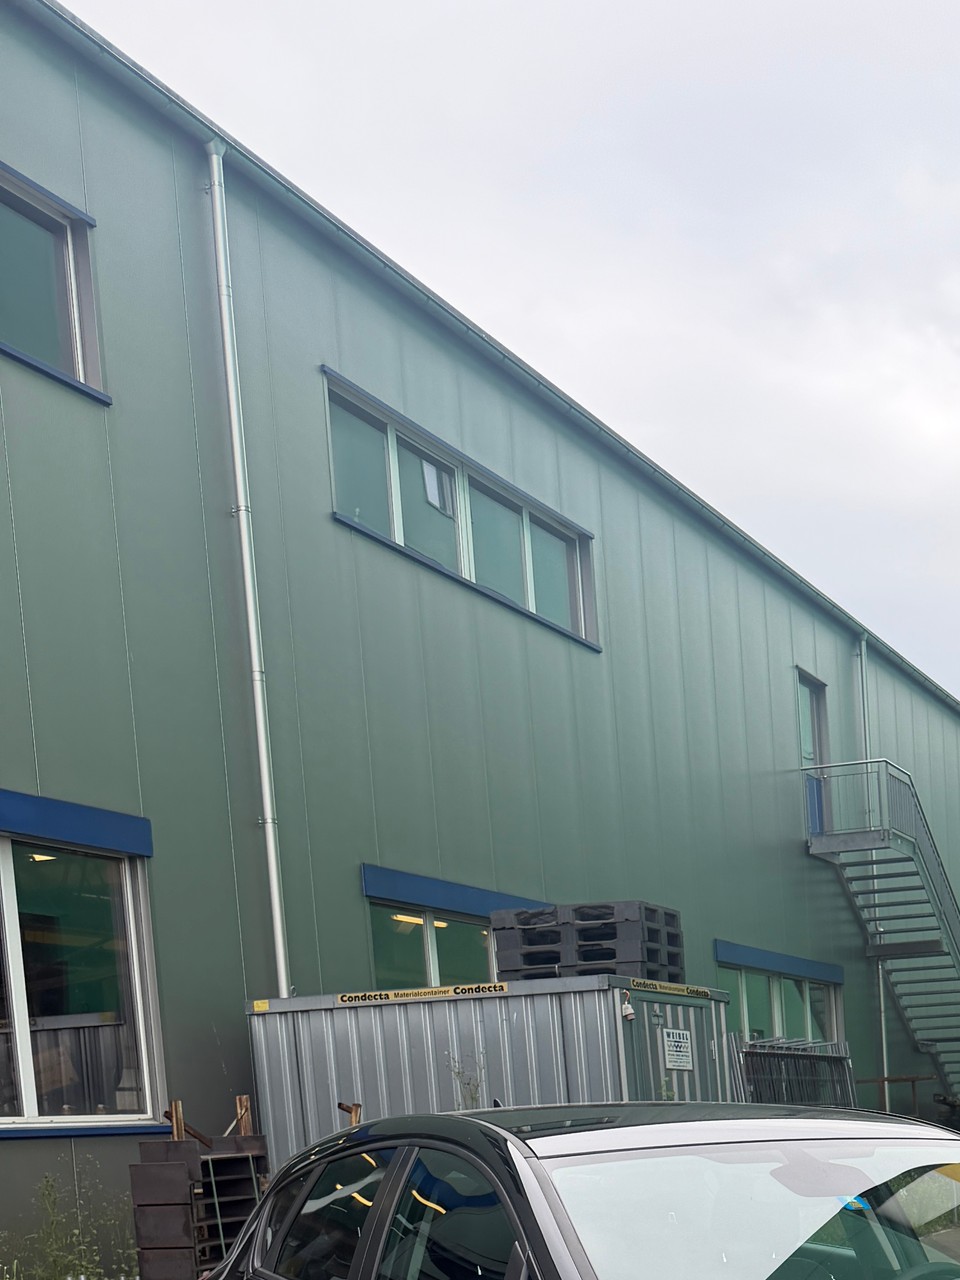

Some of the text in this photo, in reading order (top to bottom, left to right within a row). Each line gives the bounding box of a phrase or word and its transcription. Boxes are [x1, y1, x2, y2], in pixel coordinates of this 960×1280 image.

[632, 979, 658, 990] Condecta
[340, 984, 505, 1003] Condecta Materialcontainer Condecta
[666, 1031, 689, 1041] WEIBEL
